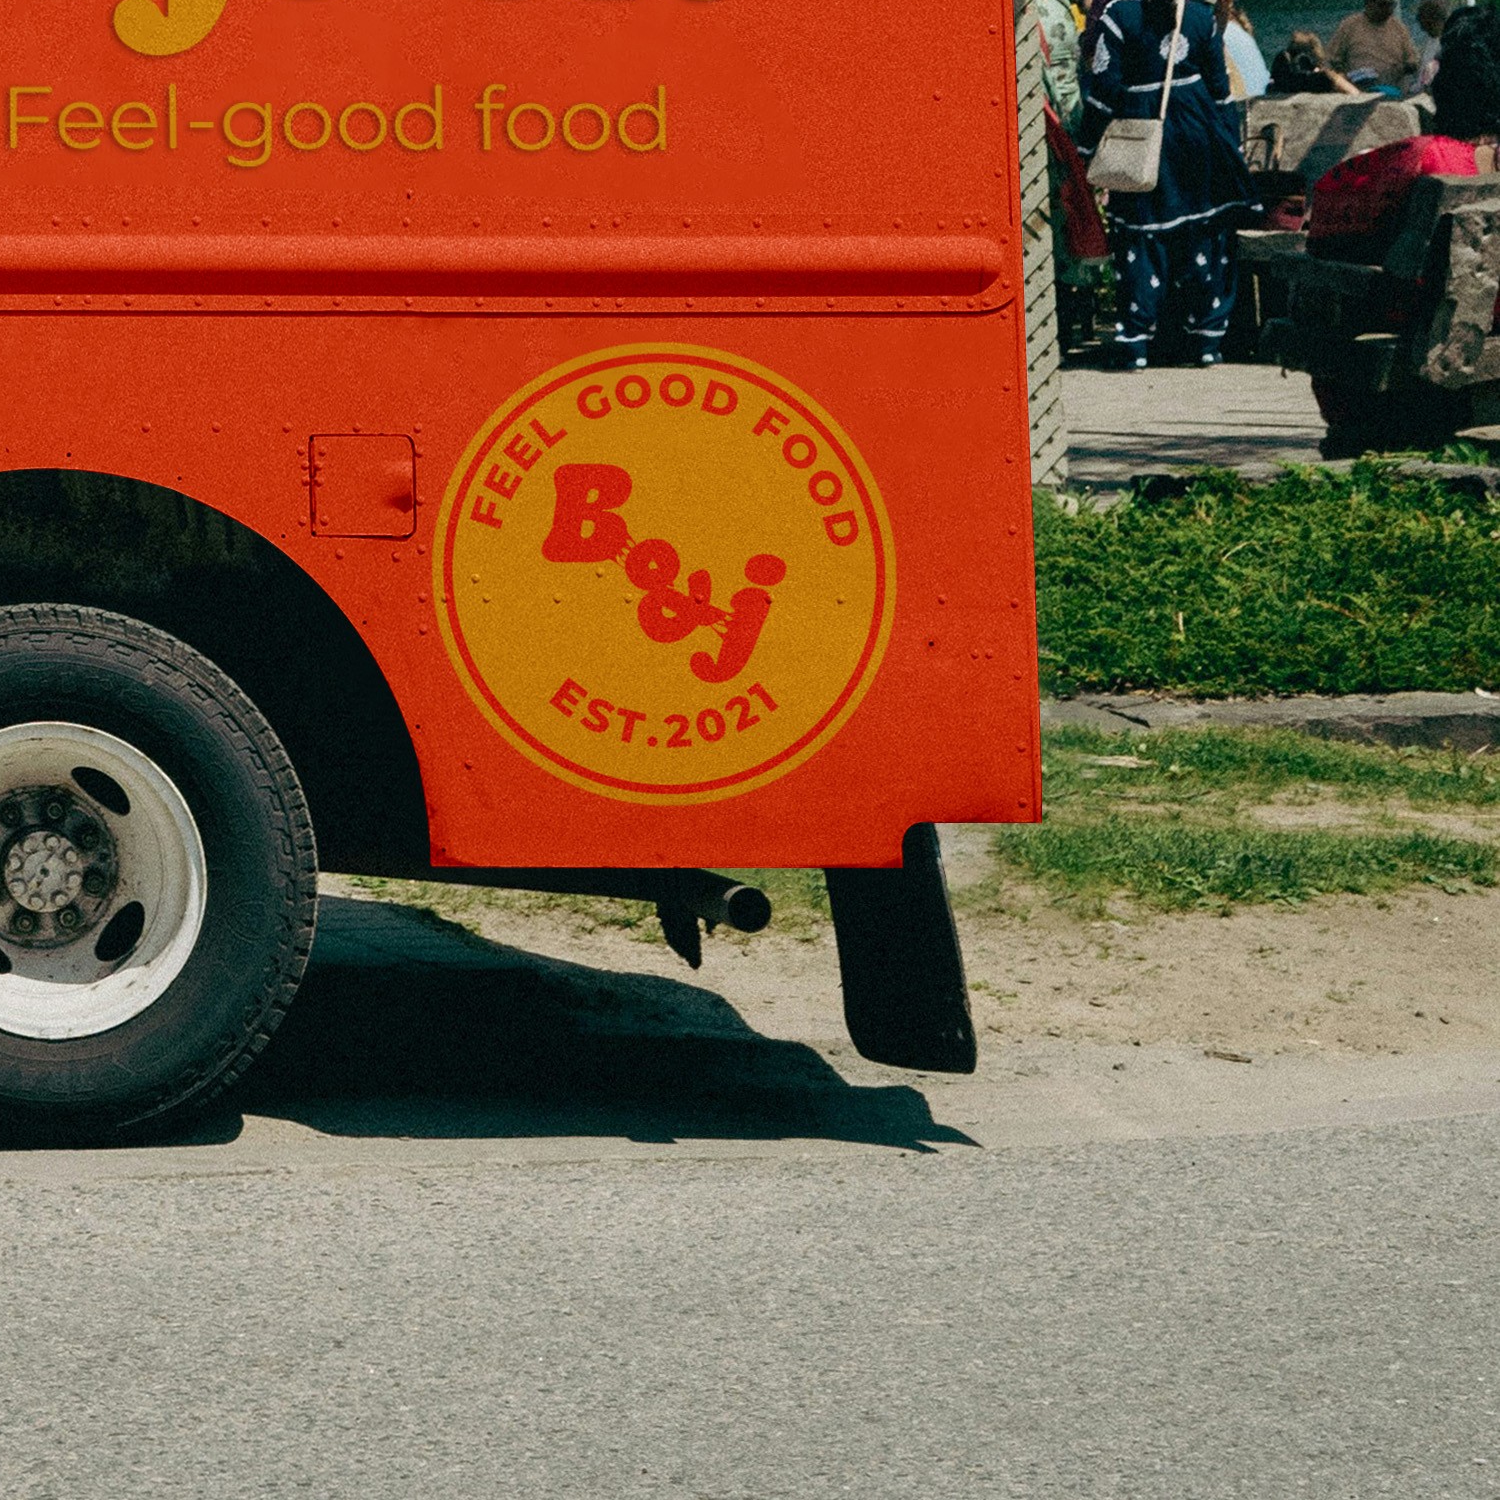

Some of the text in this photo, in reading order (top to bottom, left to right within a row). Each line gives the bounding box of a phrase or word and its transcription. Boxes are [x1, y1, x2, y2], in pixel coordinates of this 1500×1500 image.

[6, 83, 667, 167] Feel-good food
[469, 373, 860, 548] FEEL GOOD FOOD
